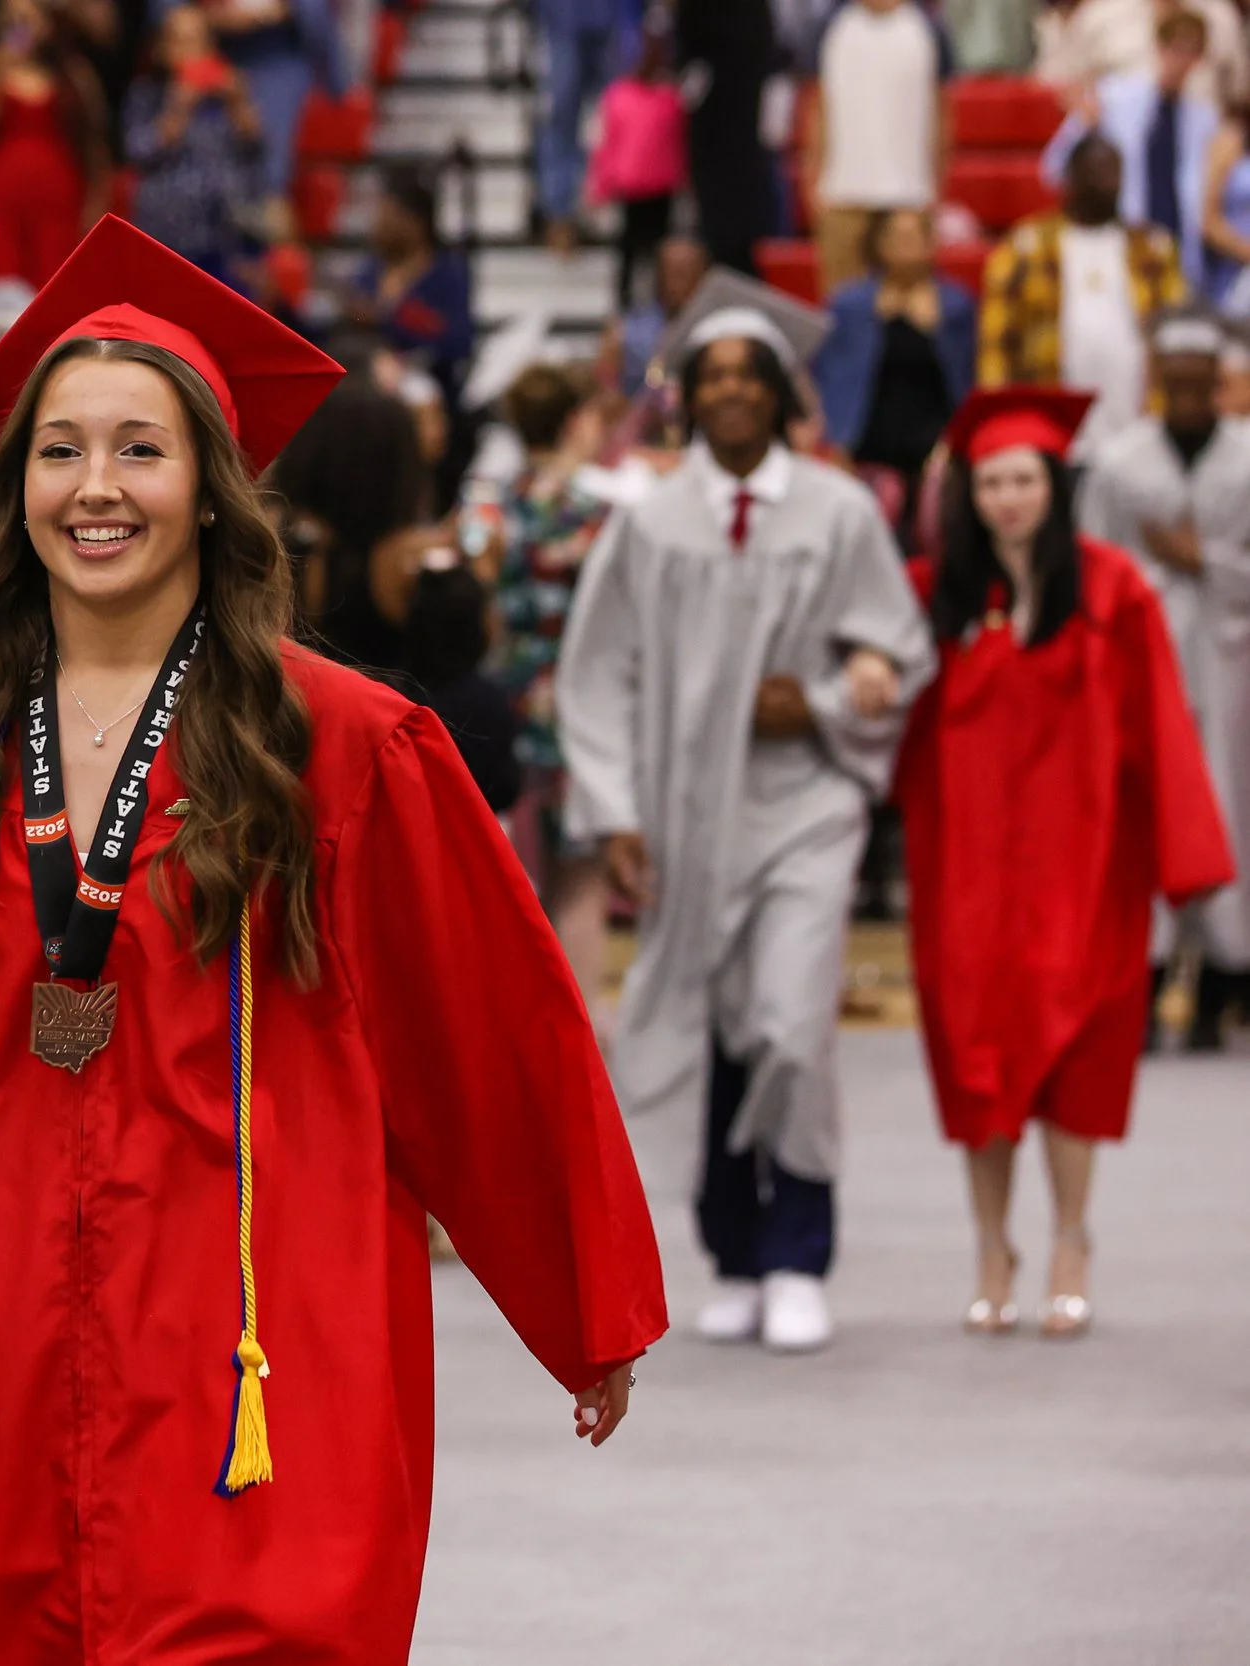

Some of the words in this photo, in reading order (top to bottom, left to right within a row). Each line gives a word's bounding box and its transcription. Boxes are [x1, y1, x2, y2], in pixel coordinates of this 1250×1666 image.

[29, 697, 51, 796] STATE
[25, 817, 66, 837] 2022
[102, 760, 151, 859] STATE
[78, 881, 123, 904] 2022
